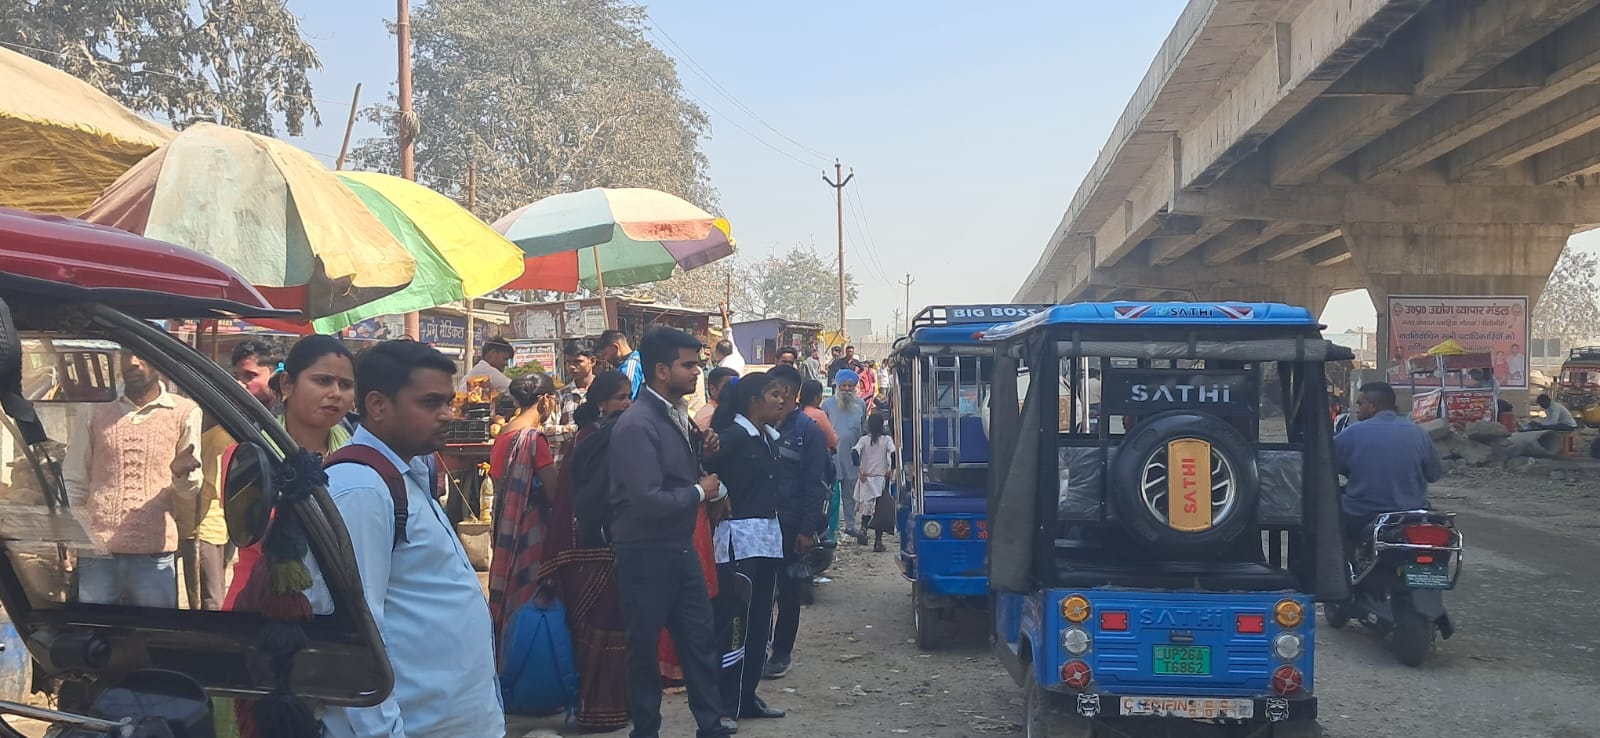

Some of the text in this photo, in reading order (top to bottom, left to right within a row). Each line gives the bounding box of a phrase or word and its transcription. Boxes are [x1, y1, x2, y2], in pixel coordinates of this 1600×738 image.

[954, 307, 1036, 318] BIG BOSS
[1456, 305, 1484, 315] व्यापार
[1163, 647, 1204, 661] UP26A
[1163, 661, 1204, 674] T6862
